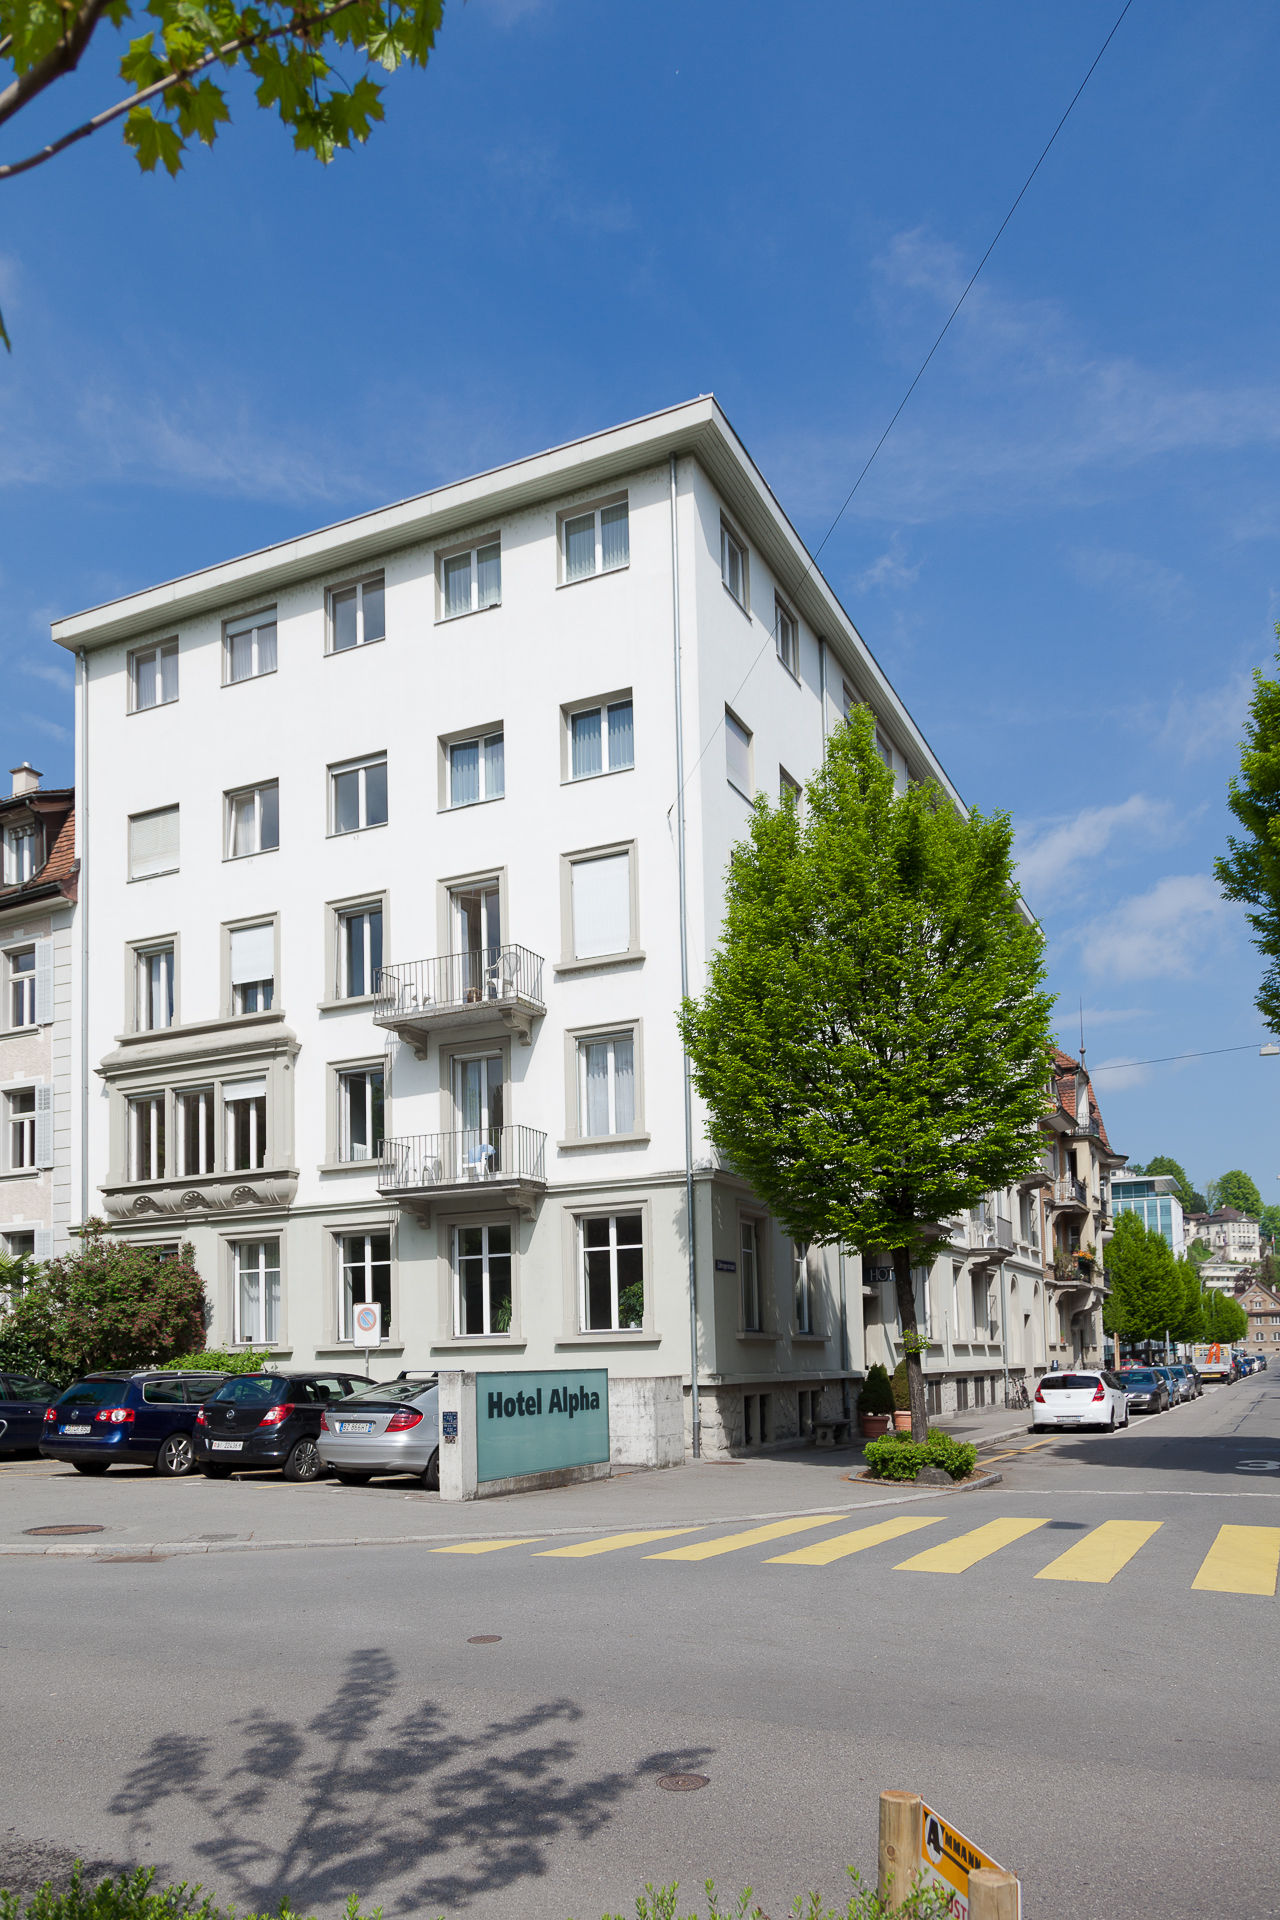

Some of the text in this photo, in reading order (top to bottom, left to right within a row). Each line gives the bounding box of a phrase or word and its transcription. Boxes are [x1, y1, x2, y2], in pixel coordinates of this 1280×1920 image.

[870, 1267, 895, 1281] HOT
[488, 1385, 600, 1419] Hotel Alpha
[924, 1810, 982, 1870] AMMANN
